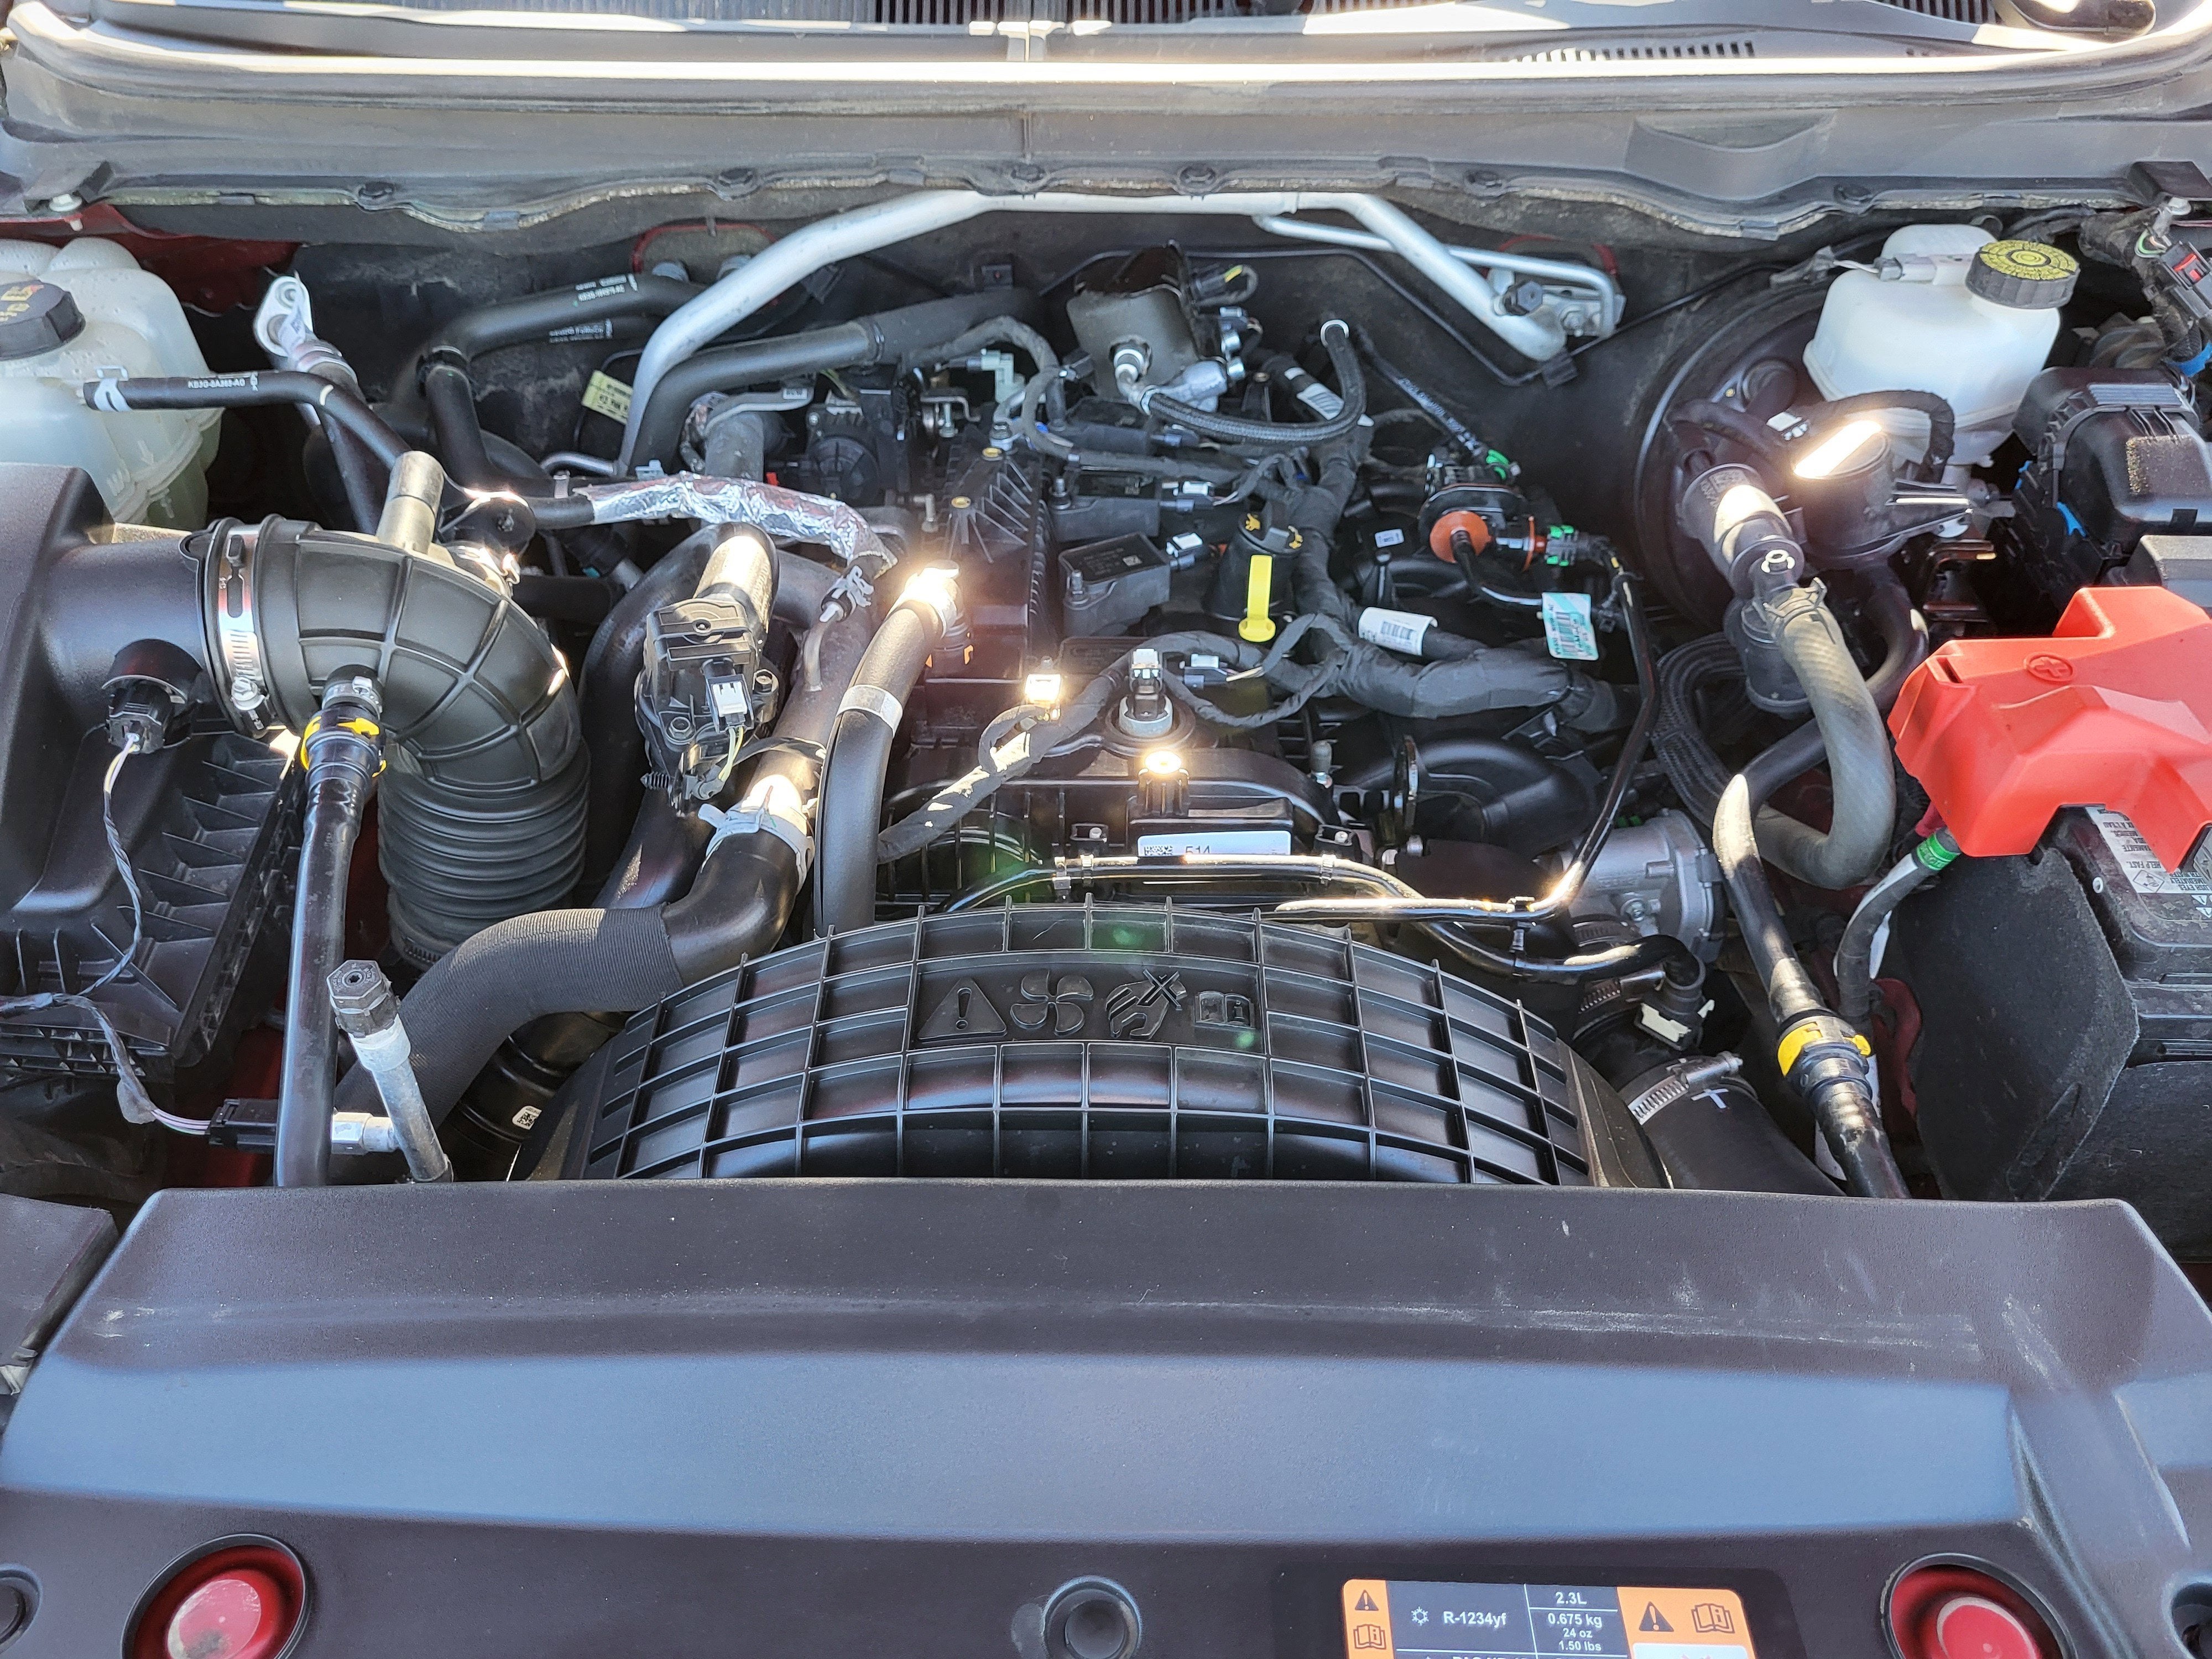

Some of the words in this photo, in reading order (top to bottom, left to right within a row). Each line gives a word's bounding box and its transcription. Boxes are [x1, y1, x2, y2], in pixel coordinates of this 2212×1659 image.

[1555, 1591, 1587, 1605] 2.3L
[1443, 1611, 1507, 1629] R-1234yf
[1548, 1613, 1582, 1625] 0.675
[1586, 1613, 1603, 1629] kg
[1563, 1627, 1576, 1638] 24
[1579, 1630, 1593, 1639] oz
[1558, 1640, 1581, 1651] 1.50
[1584, 1641, 1602, 1651] lbs
